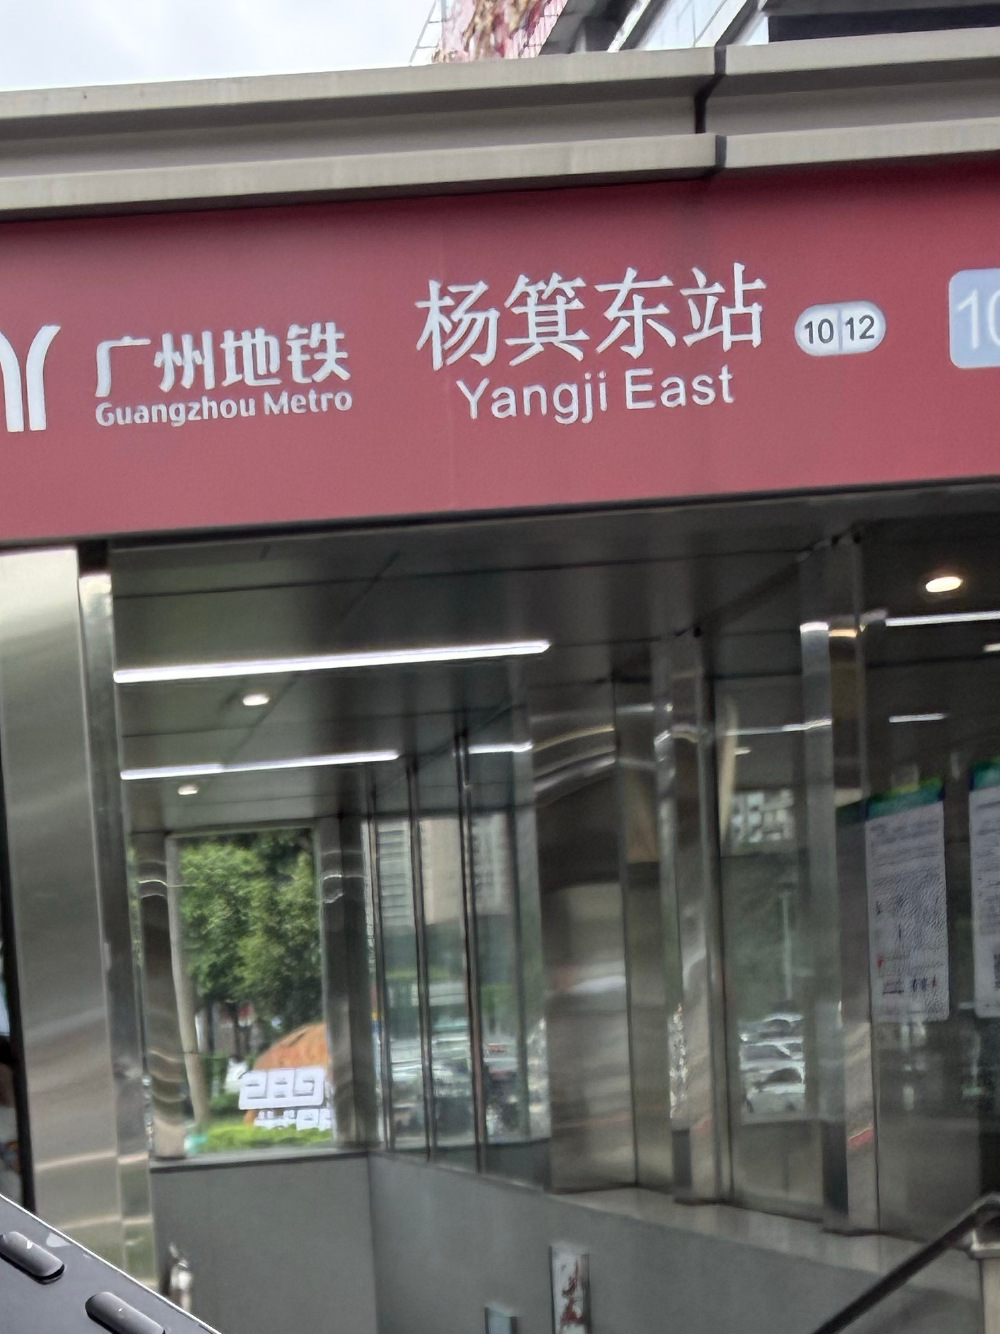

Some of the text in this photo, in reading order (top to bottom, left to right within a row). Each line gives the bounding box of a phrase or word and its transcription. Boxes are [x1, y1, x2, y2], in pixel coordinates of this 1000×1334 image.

[415, 262, 767, 371] 杨箕东站
[803, 314, 875, 344] 10 12
[95, 322, 351, 398] 广州地铁
[95, 389, 353, 427] Guangzhou Metro
[456, 364, 735, 425] Yangji East
